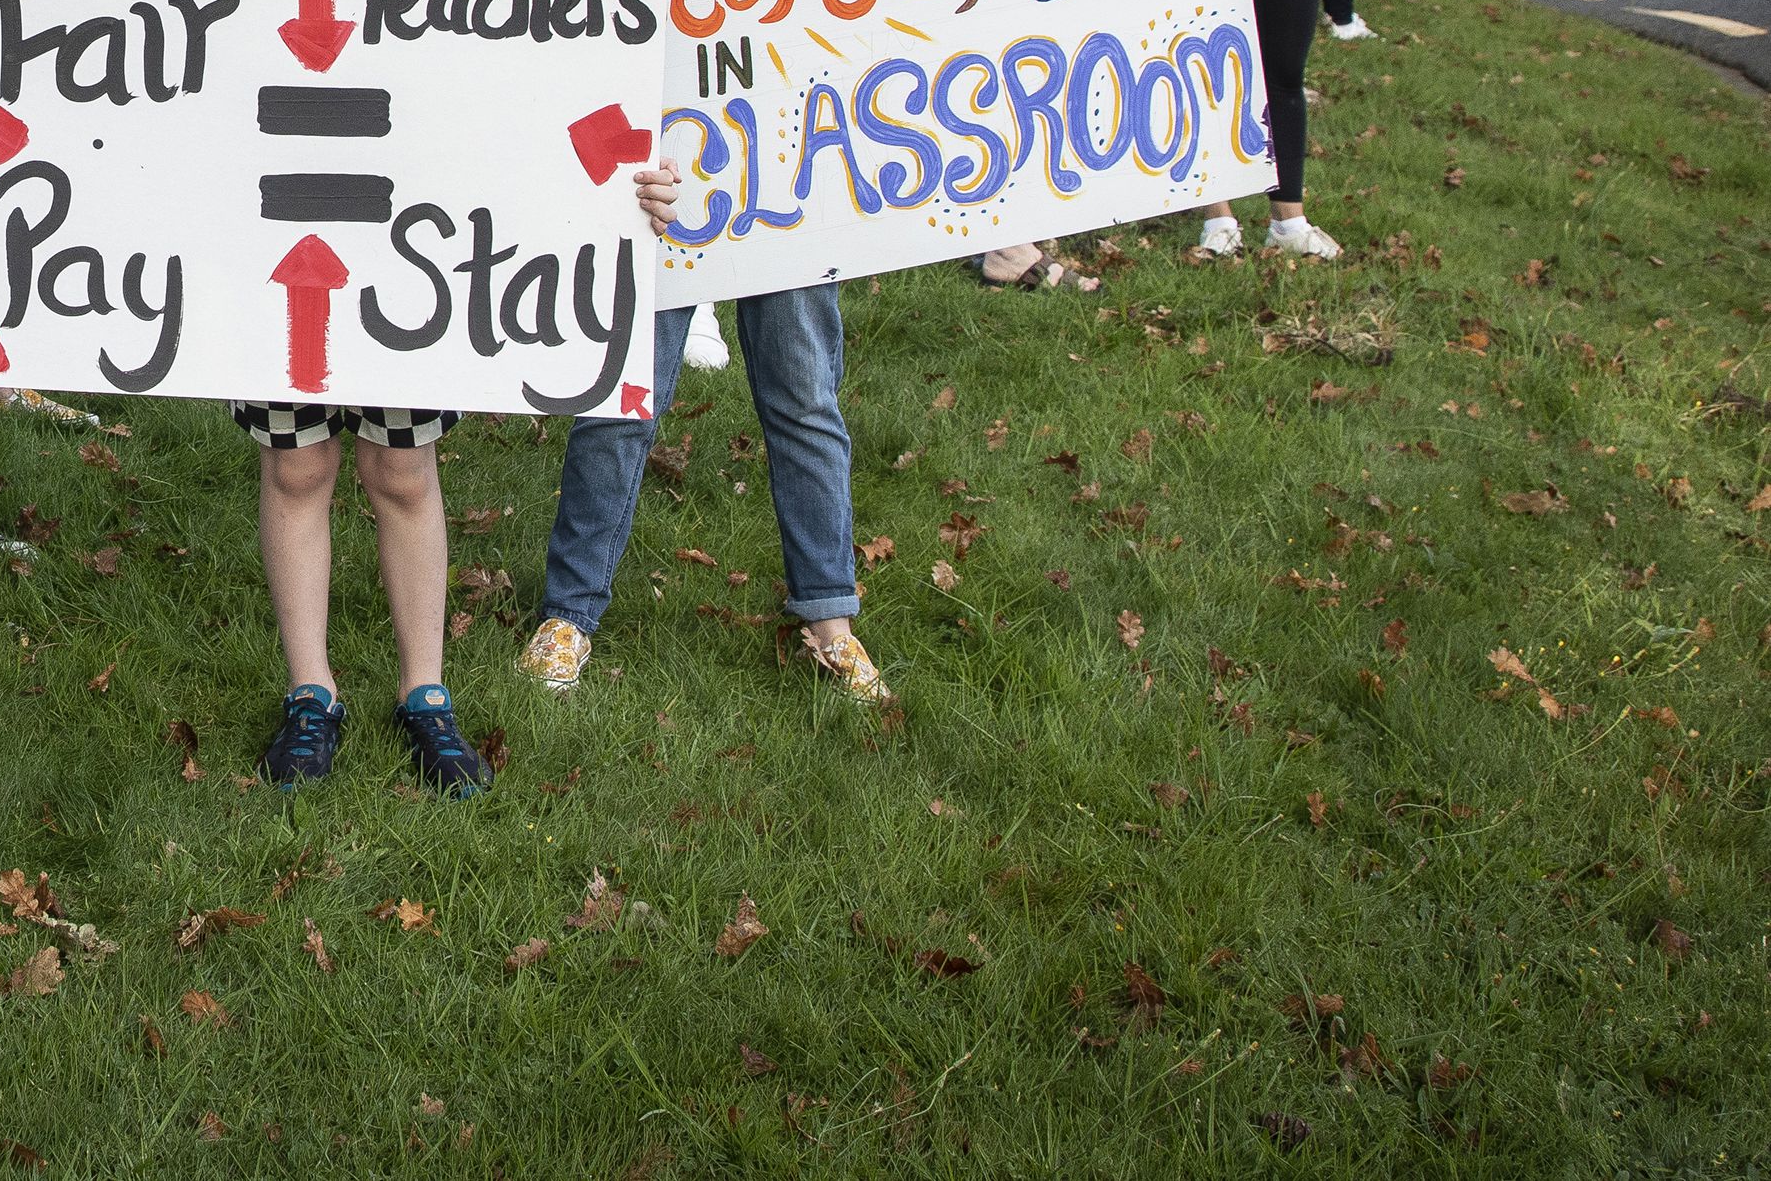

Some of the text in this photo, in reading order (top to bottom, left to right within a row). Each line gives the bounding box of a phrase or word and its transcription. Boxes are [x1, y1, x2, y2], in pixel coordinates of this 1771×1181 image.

[661, 21, 1268, 247] CLASSROOM
[695, 35, 755, 100] IN
[358, 201, 637, 416] Stay
